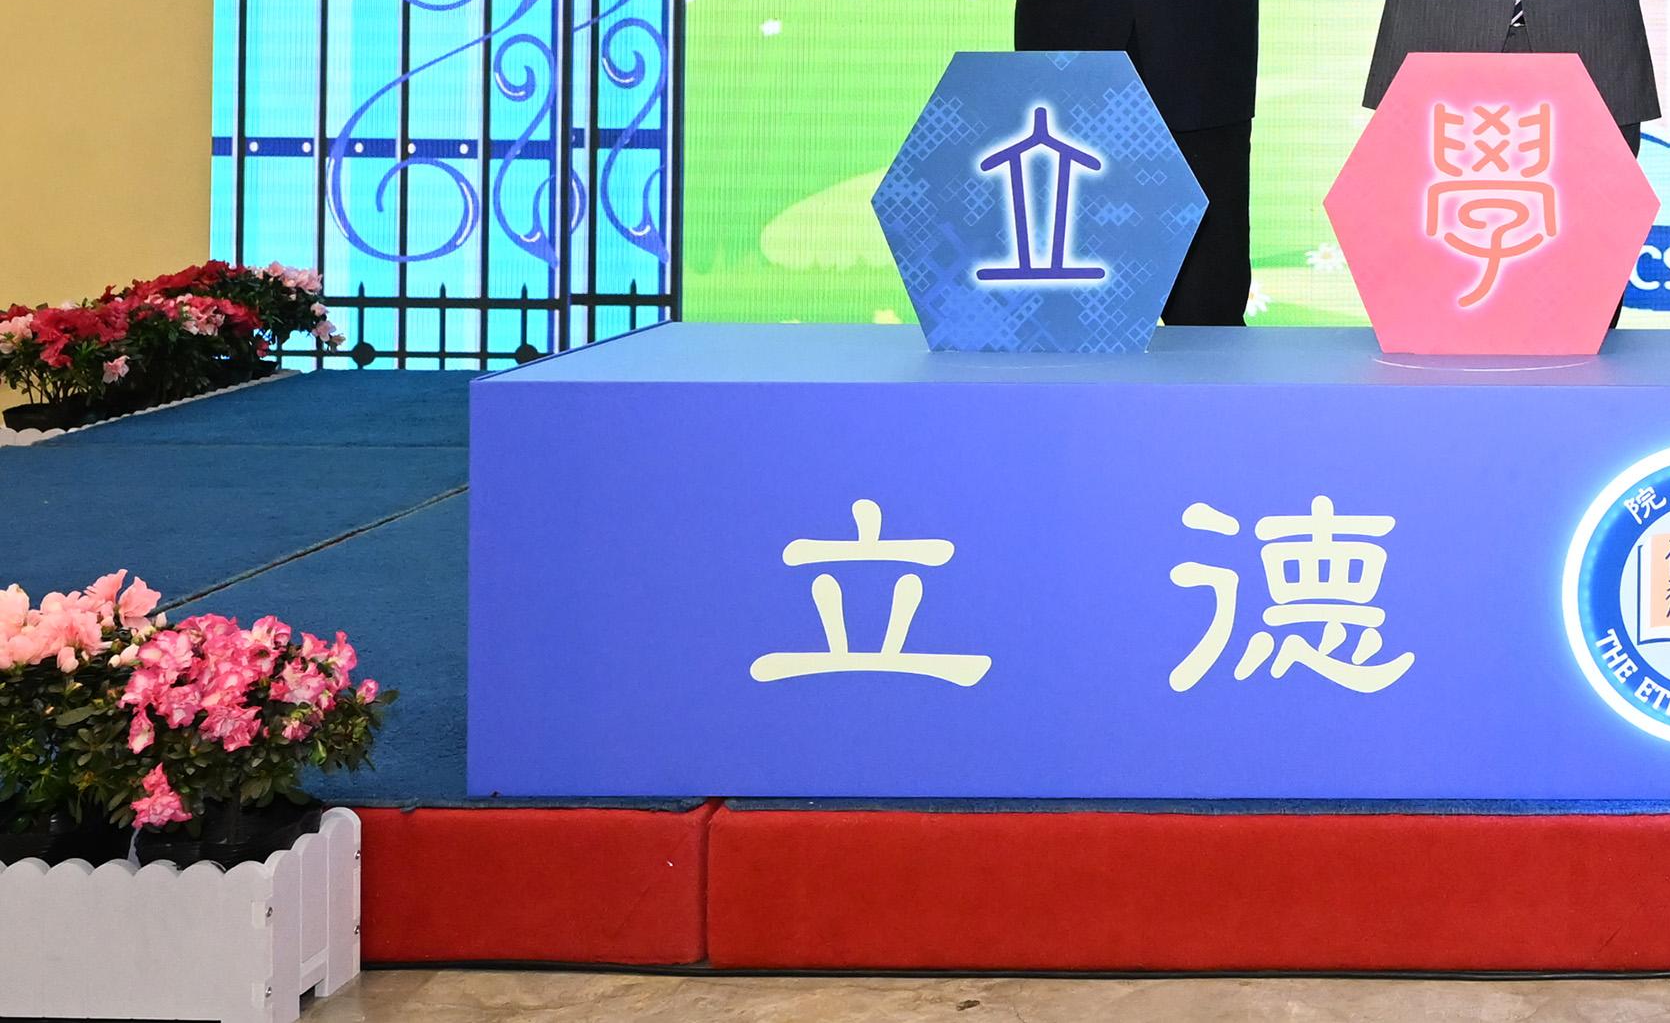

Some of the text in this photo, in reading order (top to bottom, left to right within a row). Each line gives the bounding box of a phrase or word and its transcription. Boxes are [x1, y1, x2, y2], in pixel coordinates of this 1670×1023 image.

[976, 105, 1106, 280] 立
[1426, 103, 1557, 308] 學
[1595, 629, 1639, 682] THE
